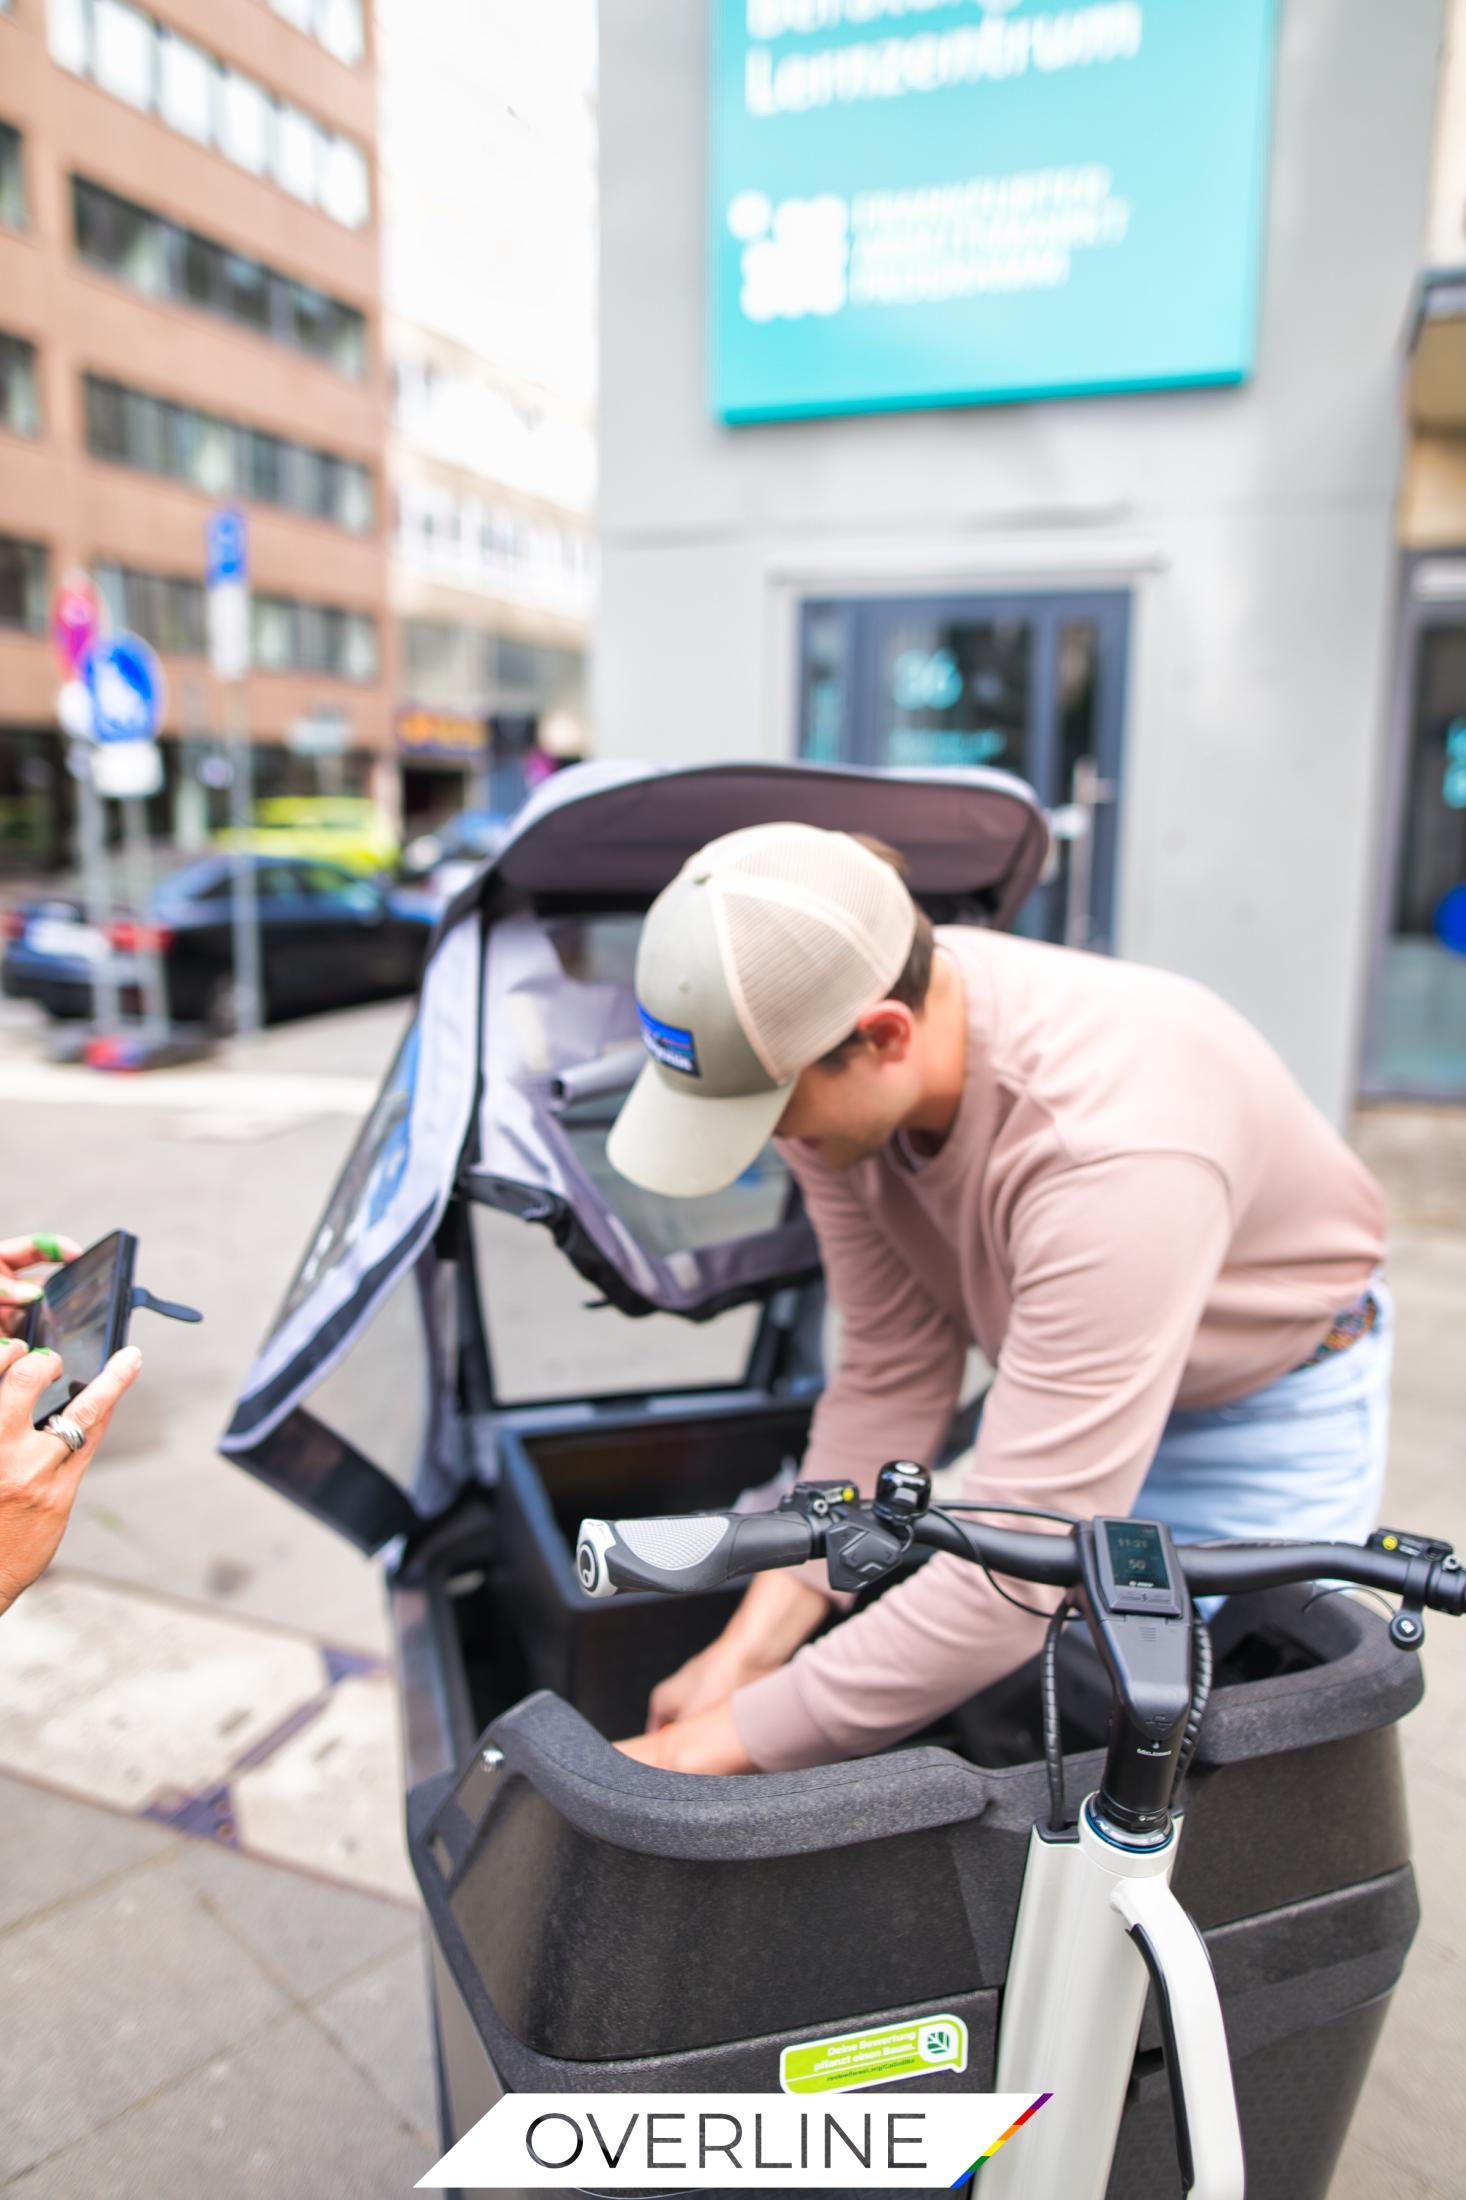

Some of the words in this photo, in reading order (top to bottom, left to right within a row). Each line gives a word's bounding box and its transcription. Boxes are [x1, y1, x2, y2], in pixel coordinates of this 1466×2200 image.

[828, 2043, 858, 2056] Deine
[859, 2032, 916, 2048] Bewertung
[814, 2056, 851, 2072] pflanzt
[853, 2050, 881, 2061] einen
[884, 2043, 915, 2055] Baum.
